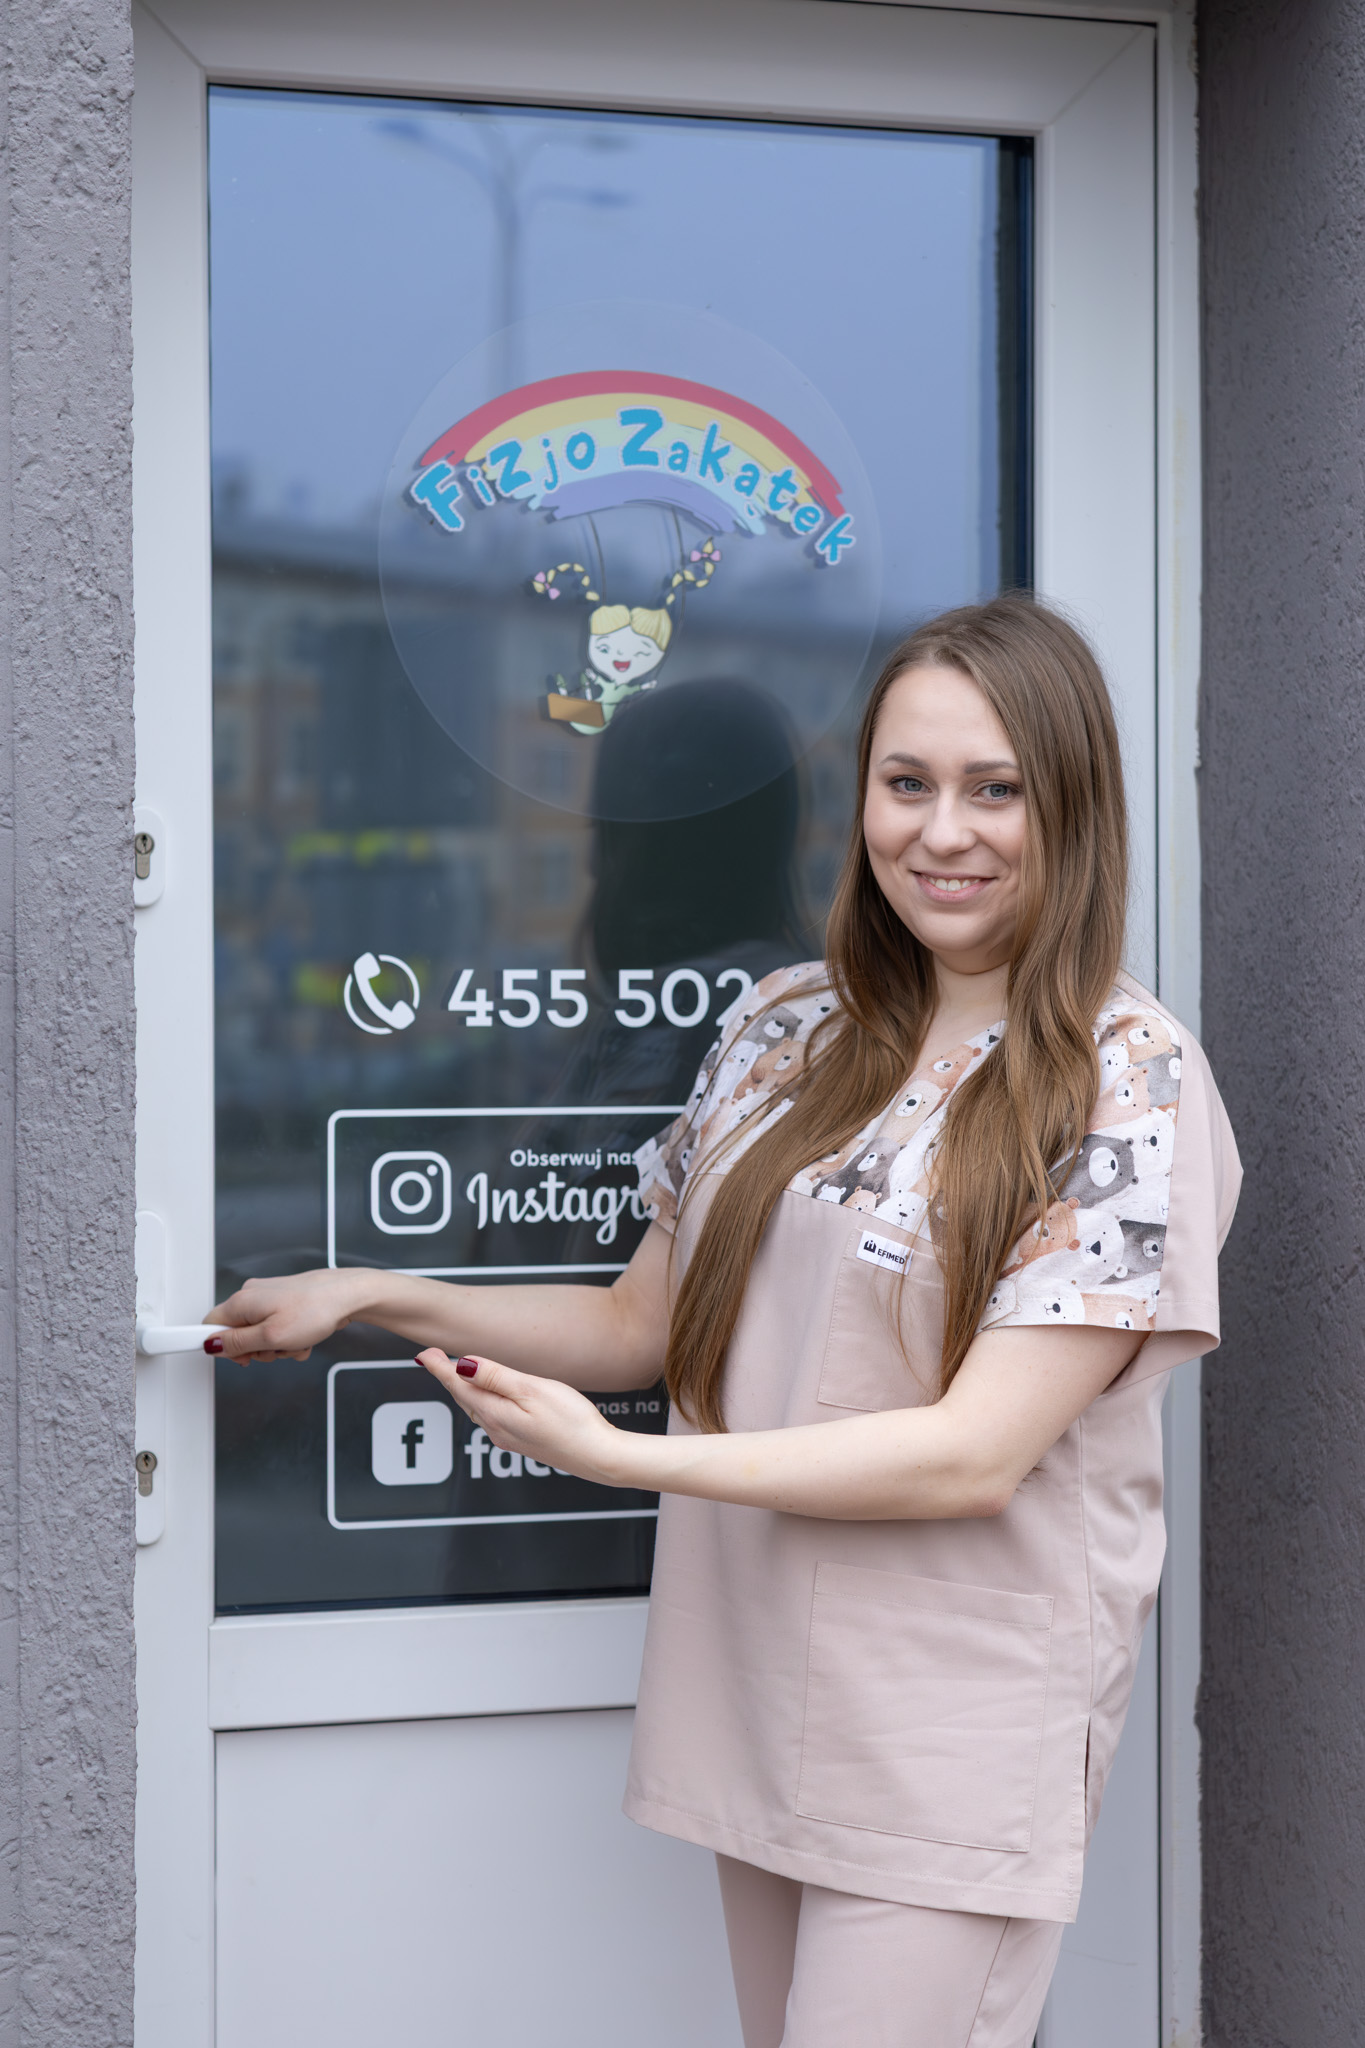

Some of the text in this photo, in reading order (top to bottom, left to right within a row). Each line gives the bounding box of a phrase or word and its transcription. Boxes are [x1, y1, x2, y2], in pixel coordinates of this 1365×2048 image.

[448, 968, 753, 1028] 455 502
[510, 1149, 601, 1170] Obserwuj
[877, 1248, 905, 1265] EFIMED
[635, 1401, 660, 1414] na
